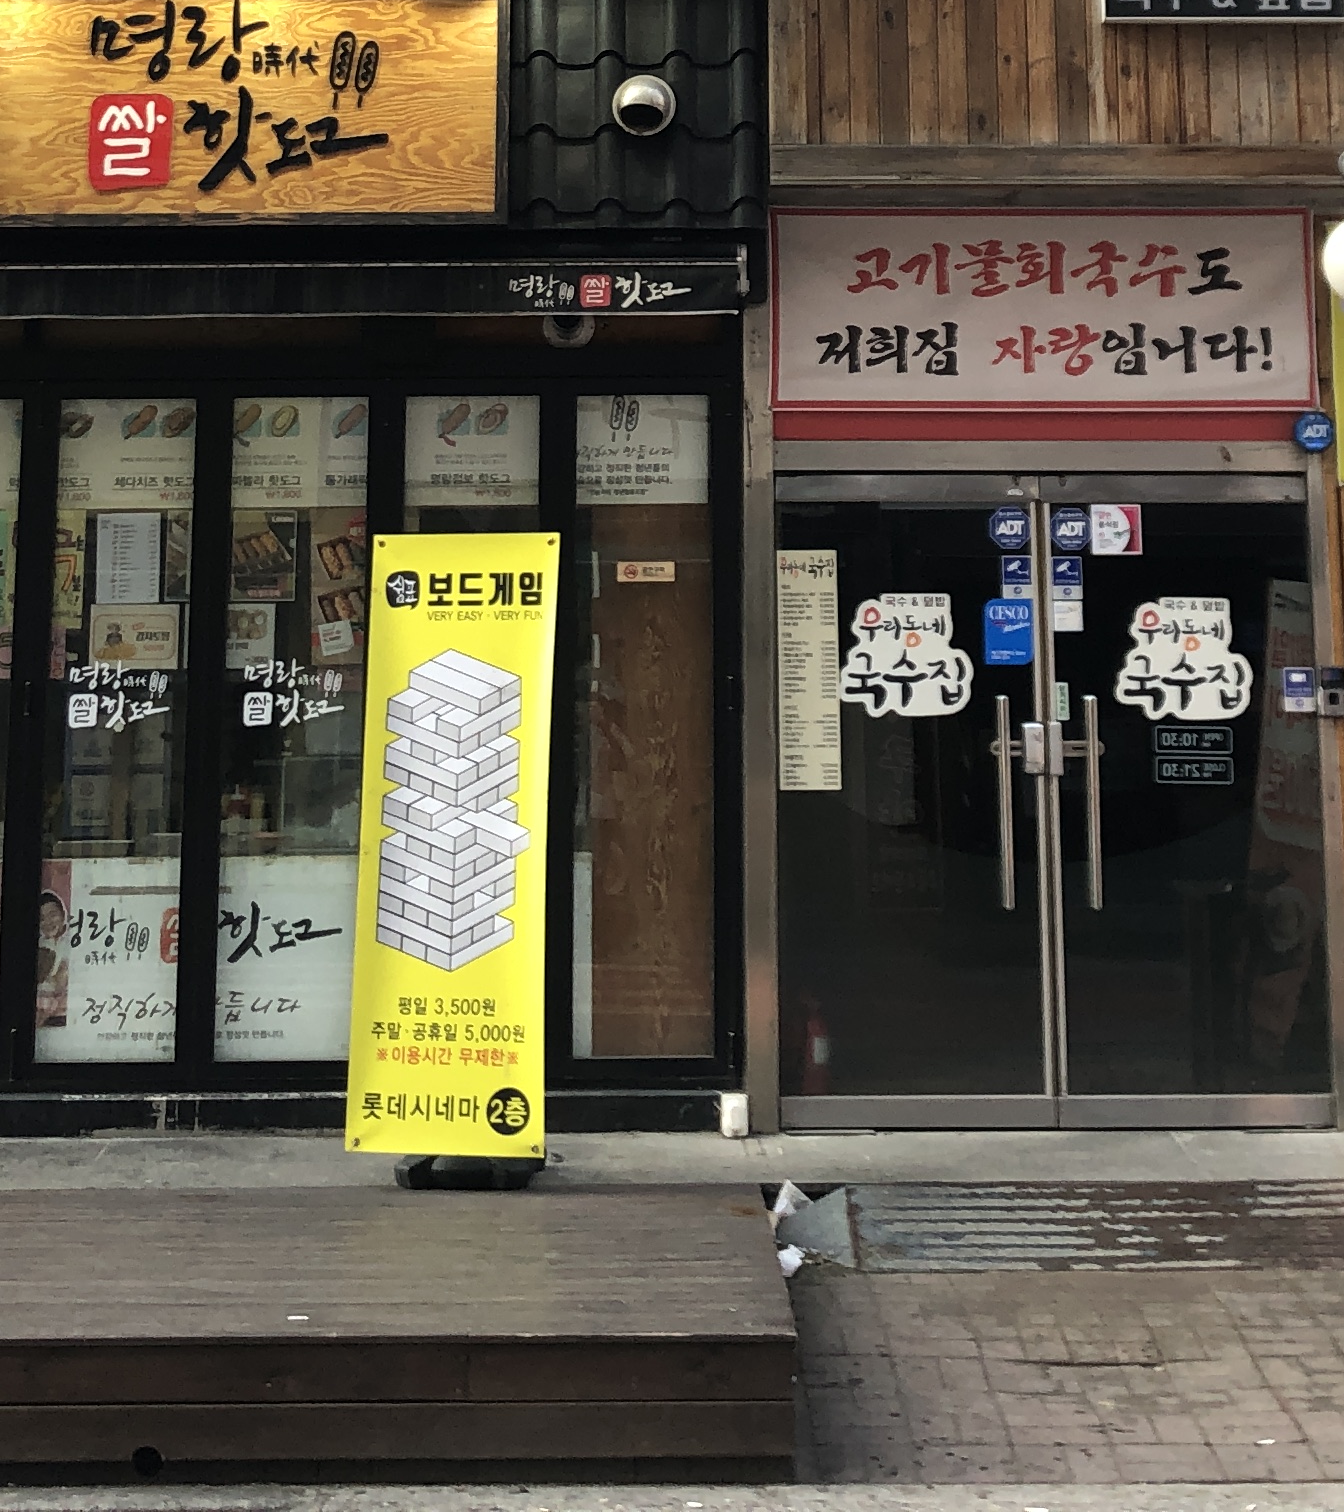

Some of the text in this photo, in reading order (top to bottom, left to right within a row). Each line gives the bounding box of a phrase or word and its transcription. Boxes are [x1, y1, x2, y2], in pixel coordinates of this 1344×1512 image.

[95, 88, 390, 191] 쌀 핫도그
[846, 240, 1243, 299] 고기물회국수도
[816, 321, 1274, 378] 저희집 자랑입니다!
[1304, 423, 1330, 439] ADT
[114, 475, 159, 488] 체다치즈
[268, 475, 301, 488] 핫도그
[478, 472, 511, 485] 핫도그
[995, 520, 1025, 536] ADT
[1055, 521, 1087, 537] ADT
[426, 572, 544, 606] 보드게임
[885, 596, 907, 607] 국수
[923, 596, 947, 608] 덮밥
[988, 604, 1029, 621] CESCO
[1164, 600, 1188, 611] 국수
[1202, 600, 1226, 612] 덮밥
[426, 611, 453, 621] VERY
[457, 611, 484, 621] EASY
[493, 611, 520, 621] VERY
[859, 606, 947, 648] 우리동네
[1137, 609, 1226, 652] 우리동네
[68, 660, 131, 690] 명랑
[243, 658, 306, 689] 명랑
[845, 648, 967, 711] 국수집
[1123, 654, 1245, 712] 국수집
[398, 996, 497, 1017] 평일 3,500원
[464, 1024, 526, 1044] 5,000원
[361, 1092, 528, 1128] 롯데시네마 2층
